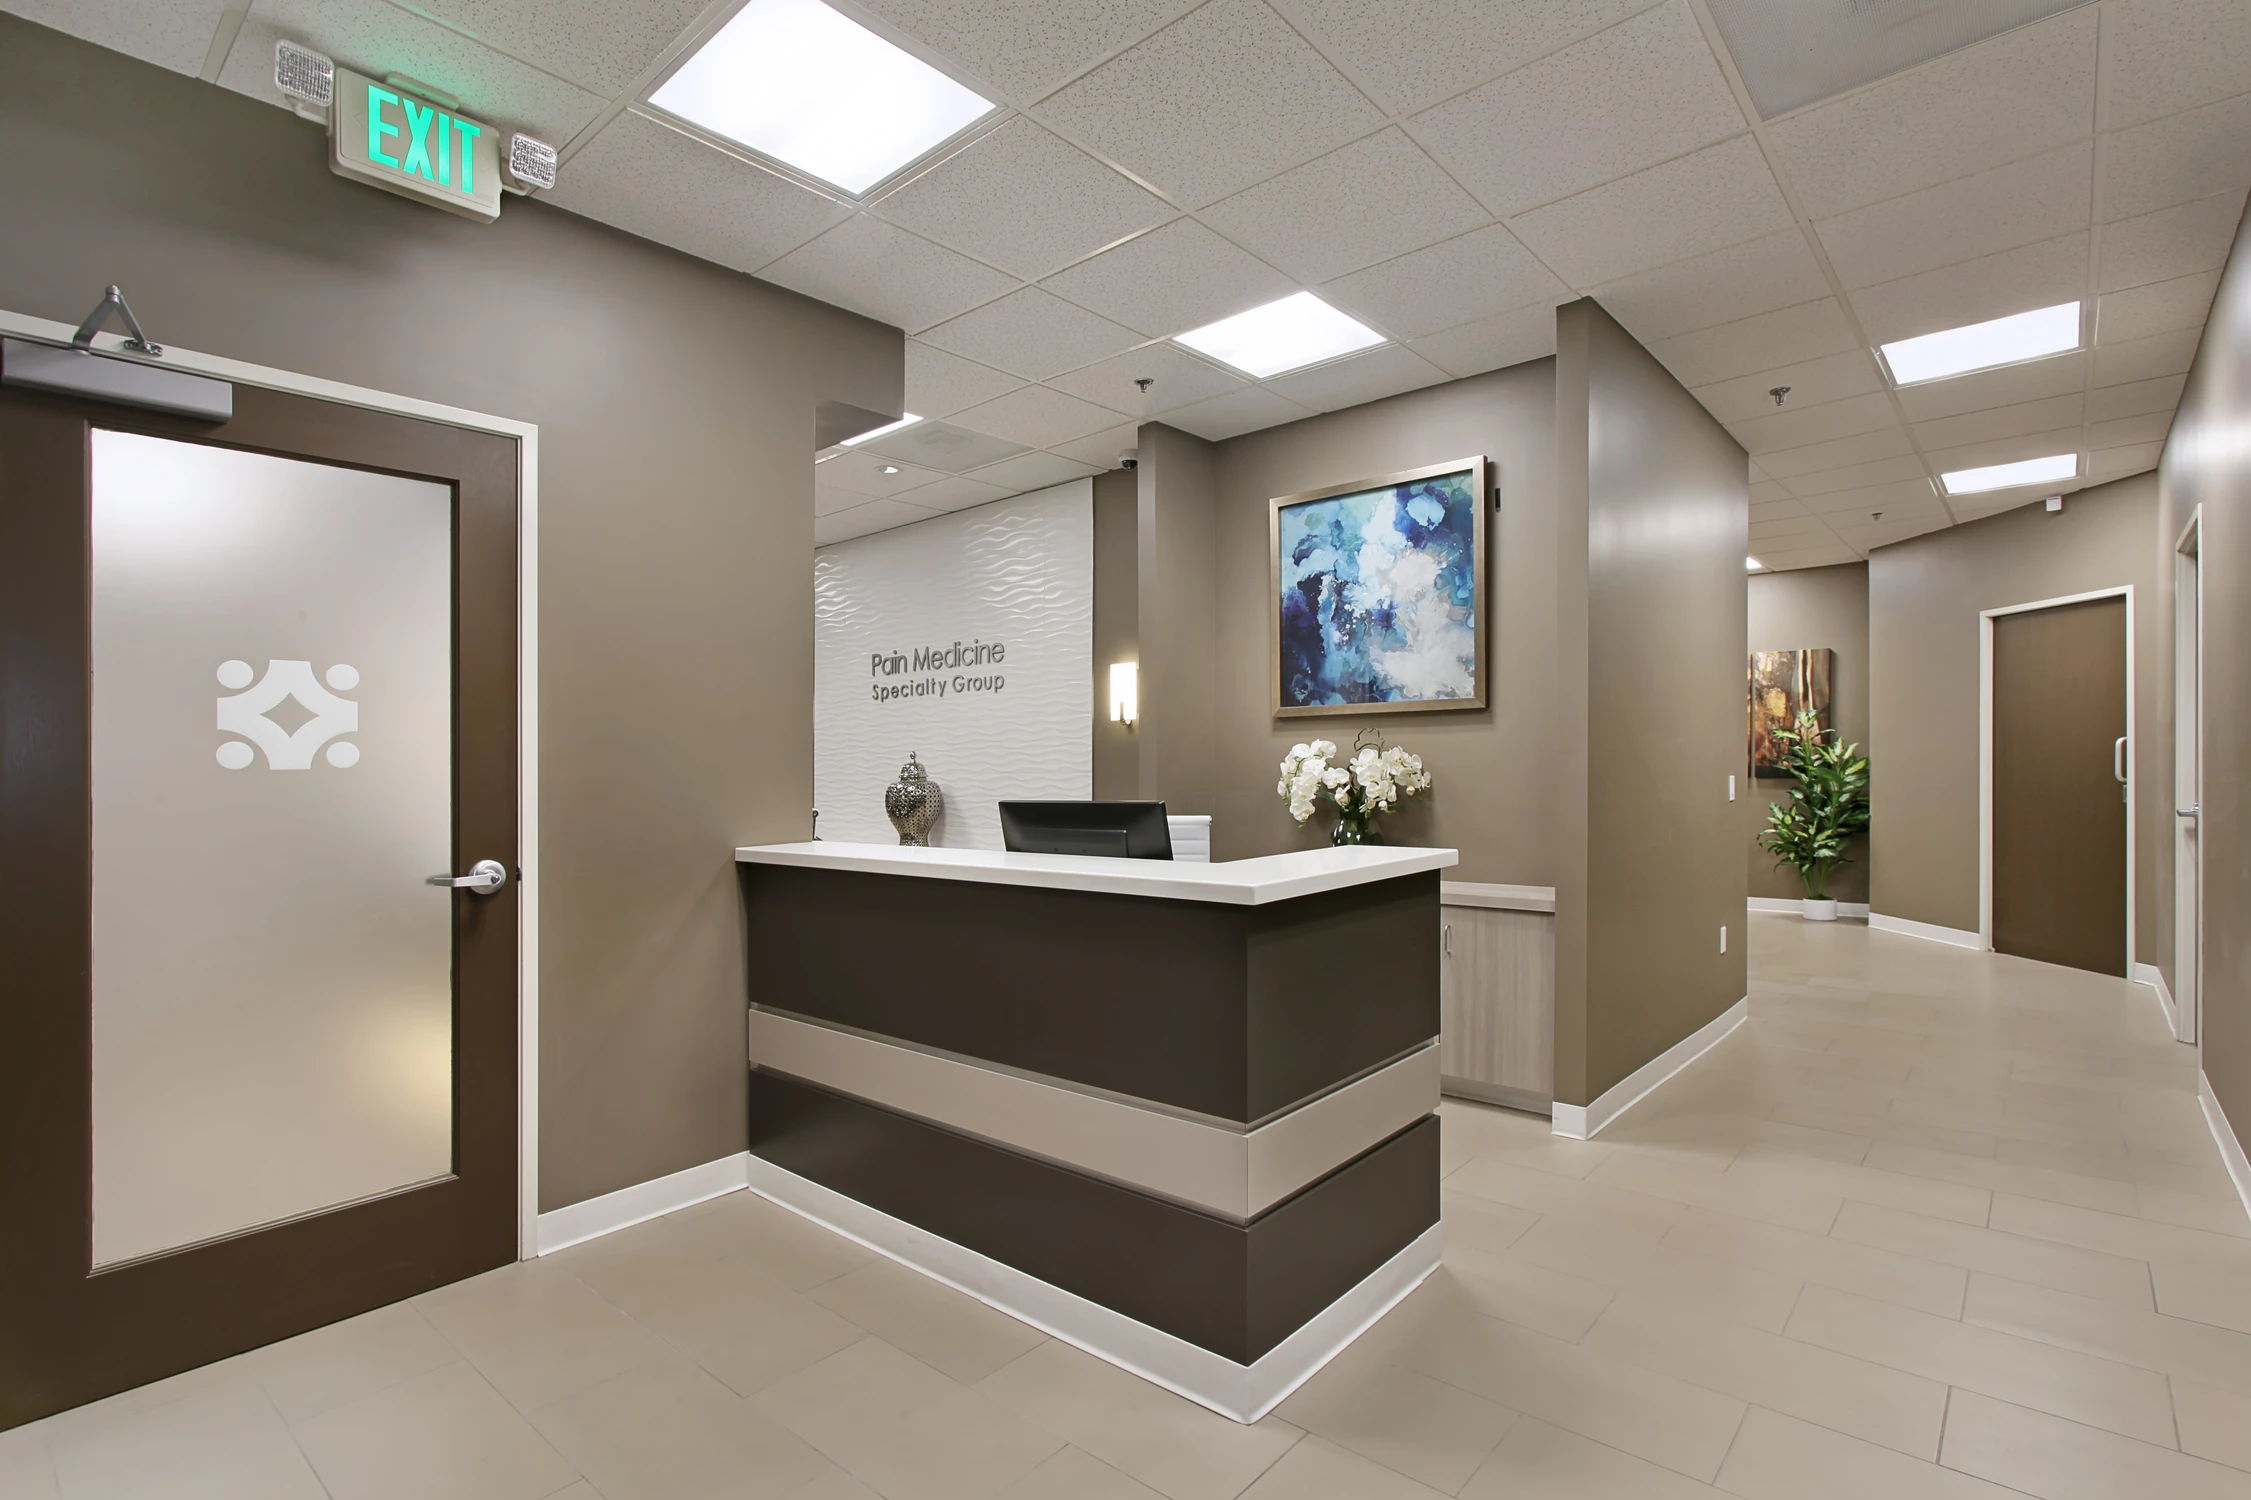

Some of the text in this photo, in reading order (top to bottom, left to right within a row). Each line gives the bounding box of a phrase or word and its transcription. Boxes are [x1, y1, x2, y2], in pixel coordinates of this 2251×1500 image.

[368, 84, 481, 195] EXIT
[871, 639, 1005, 677] Pain Medicine
[872, 674, 1005, 703] Specialty Group
